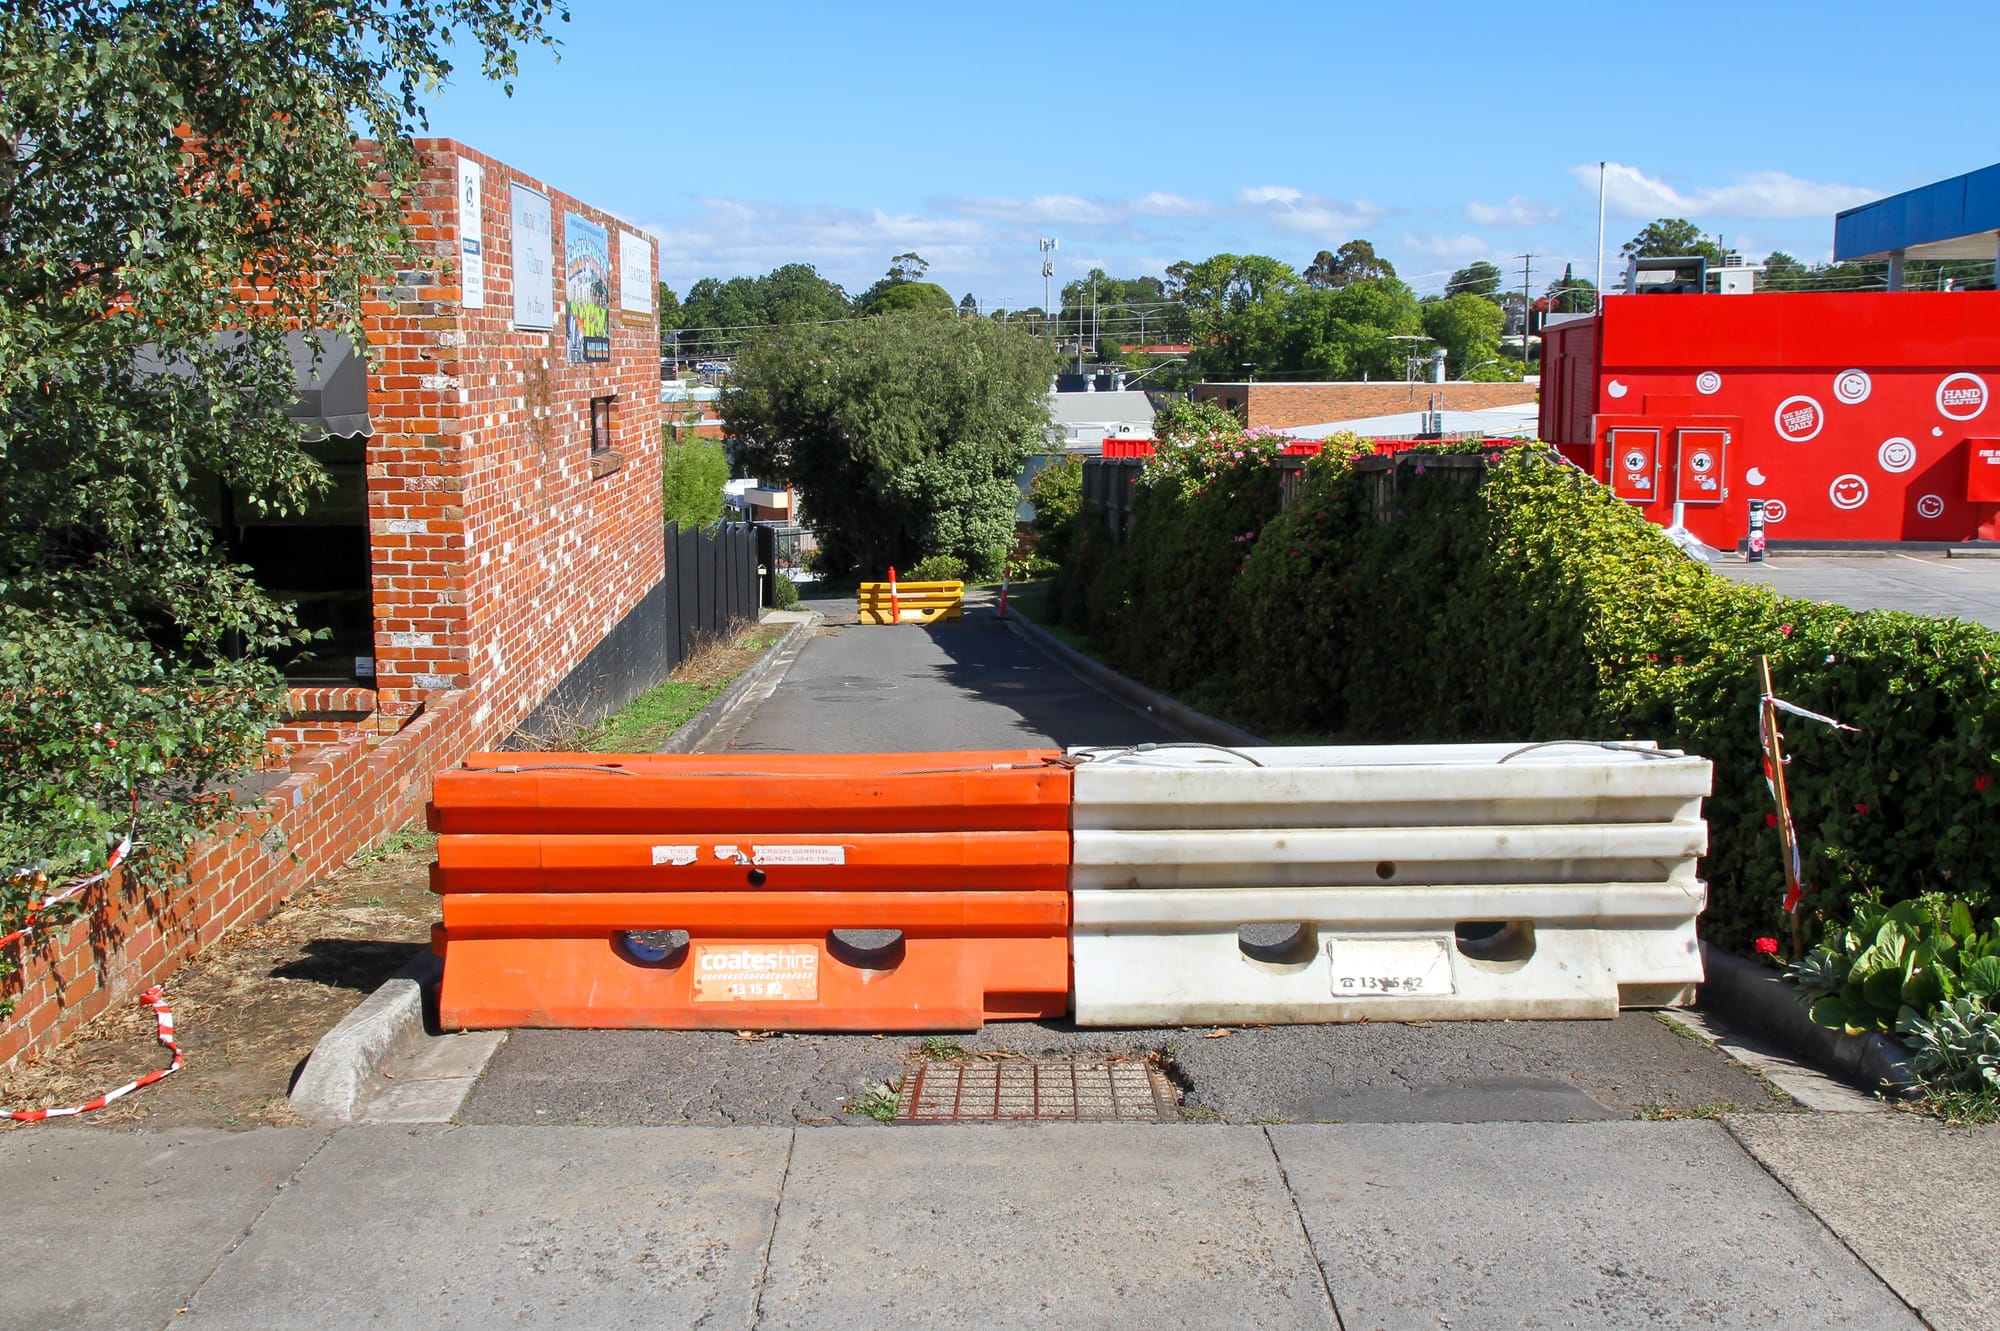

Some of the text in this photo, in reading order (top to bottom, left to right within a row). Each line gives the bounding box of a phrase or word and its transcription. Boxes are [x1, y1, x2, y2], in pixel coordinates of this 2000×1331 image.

[1944, 388, 1980, 399] HAND
[1784, 412, 1814, 426] FRESH
[1788, 419, 1813, 432] DAILY
[1359, 977, 1378, 988] 13
[733, 984, 745, 995] 13
[749, 984, 763, 995] 15
